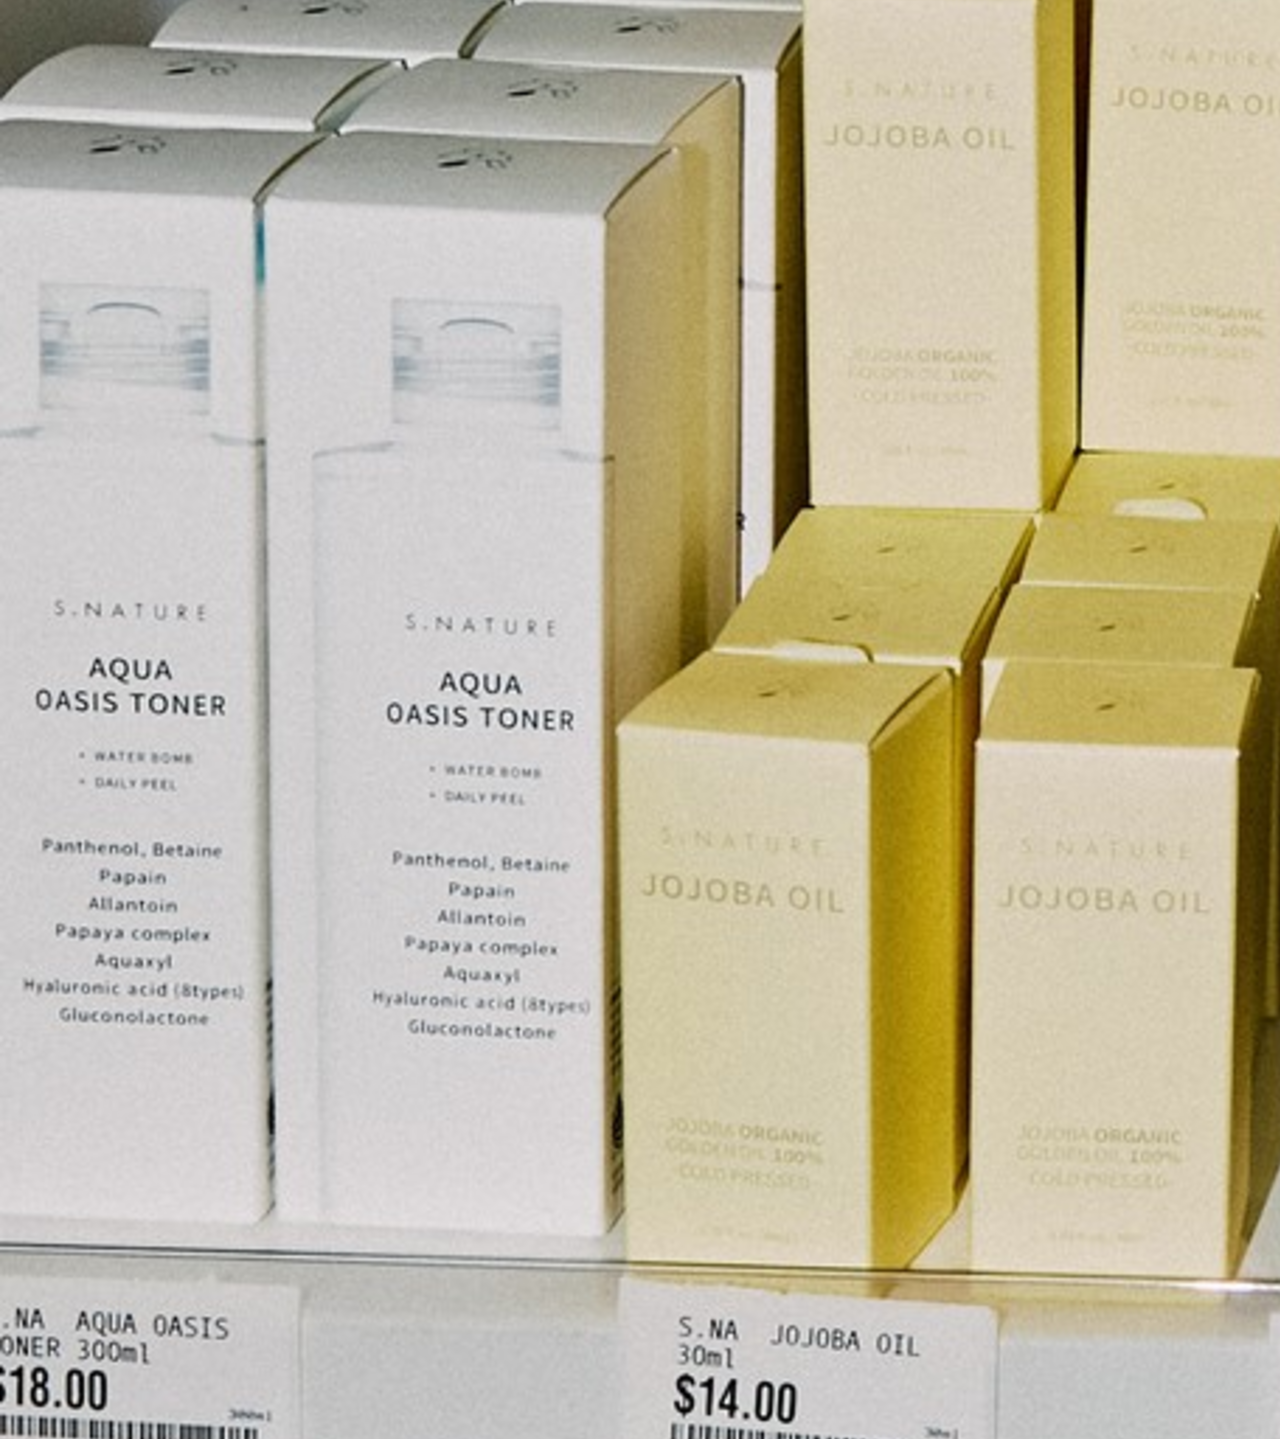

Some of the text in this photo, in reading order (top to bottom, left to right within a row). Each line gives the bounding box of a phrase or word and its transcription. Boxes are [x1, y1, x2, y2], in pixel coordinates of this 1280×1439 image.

[54, 599, 208, 623] S.NATURE
[88, 656, 173, 684] AQUA
[35, 688, 227, 718] OASIS TONER
[42, 836, 223, 862] Panthenol, Betaine
[641, 873, 845, 914] JOJOBA OIL
[76, 1310, 230, 1341] AQUA OASIS
[678, 1316, 920, 1357] S.NA JOJOBA OIL
[677, 1344, 734, 1369] 30ml
[673, 1373, 797, 1424] $14.00
